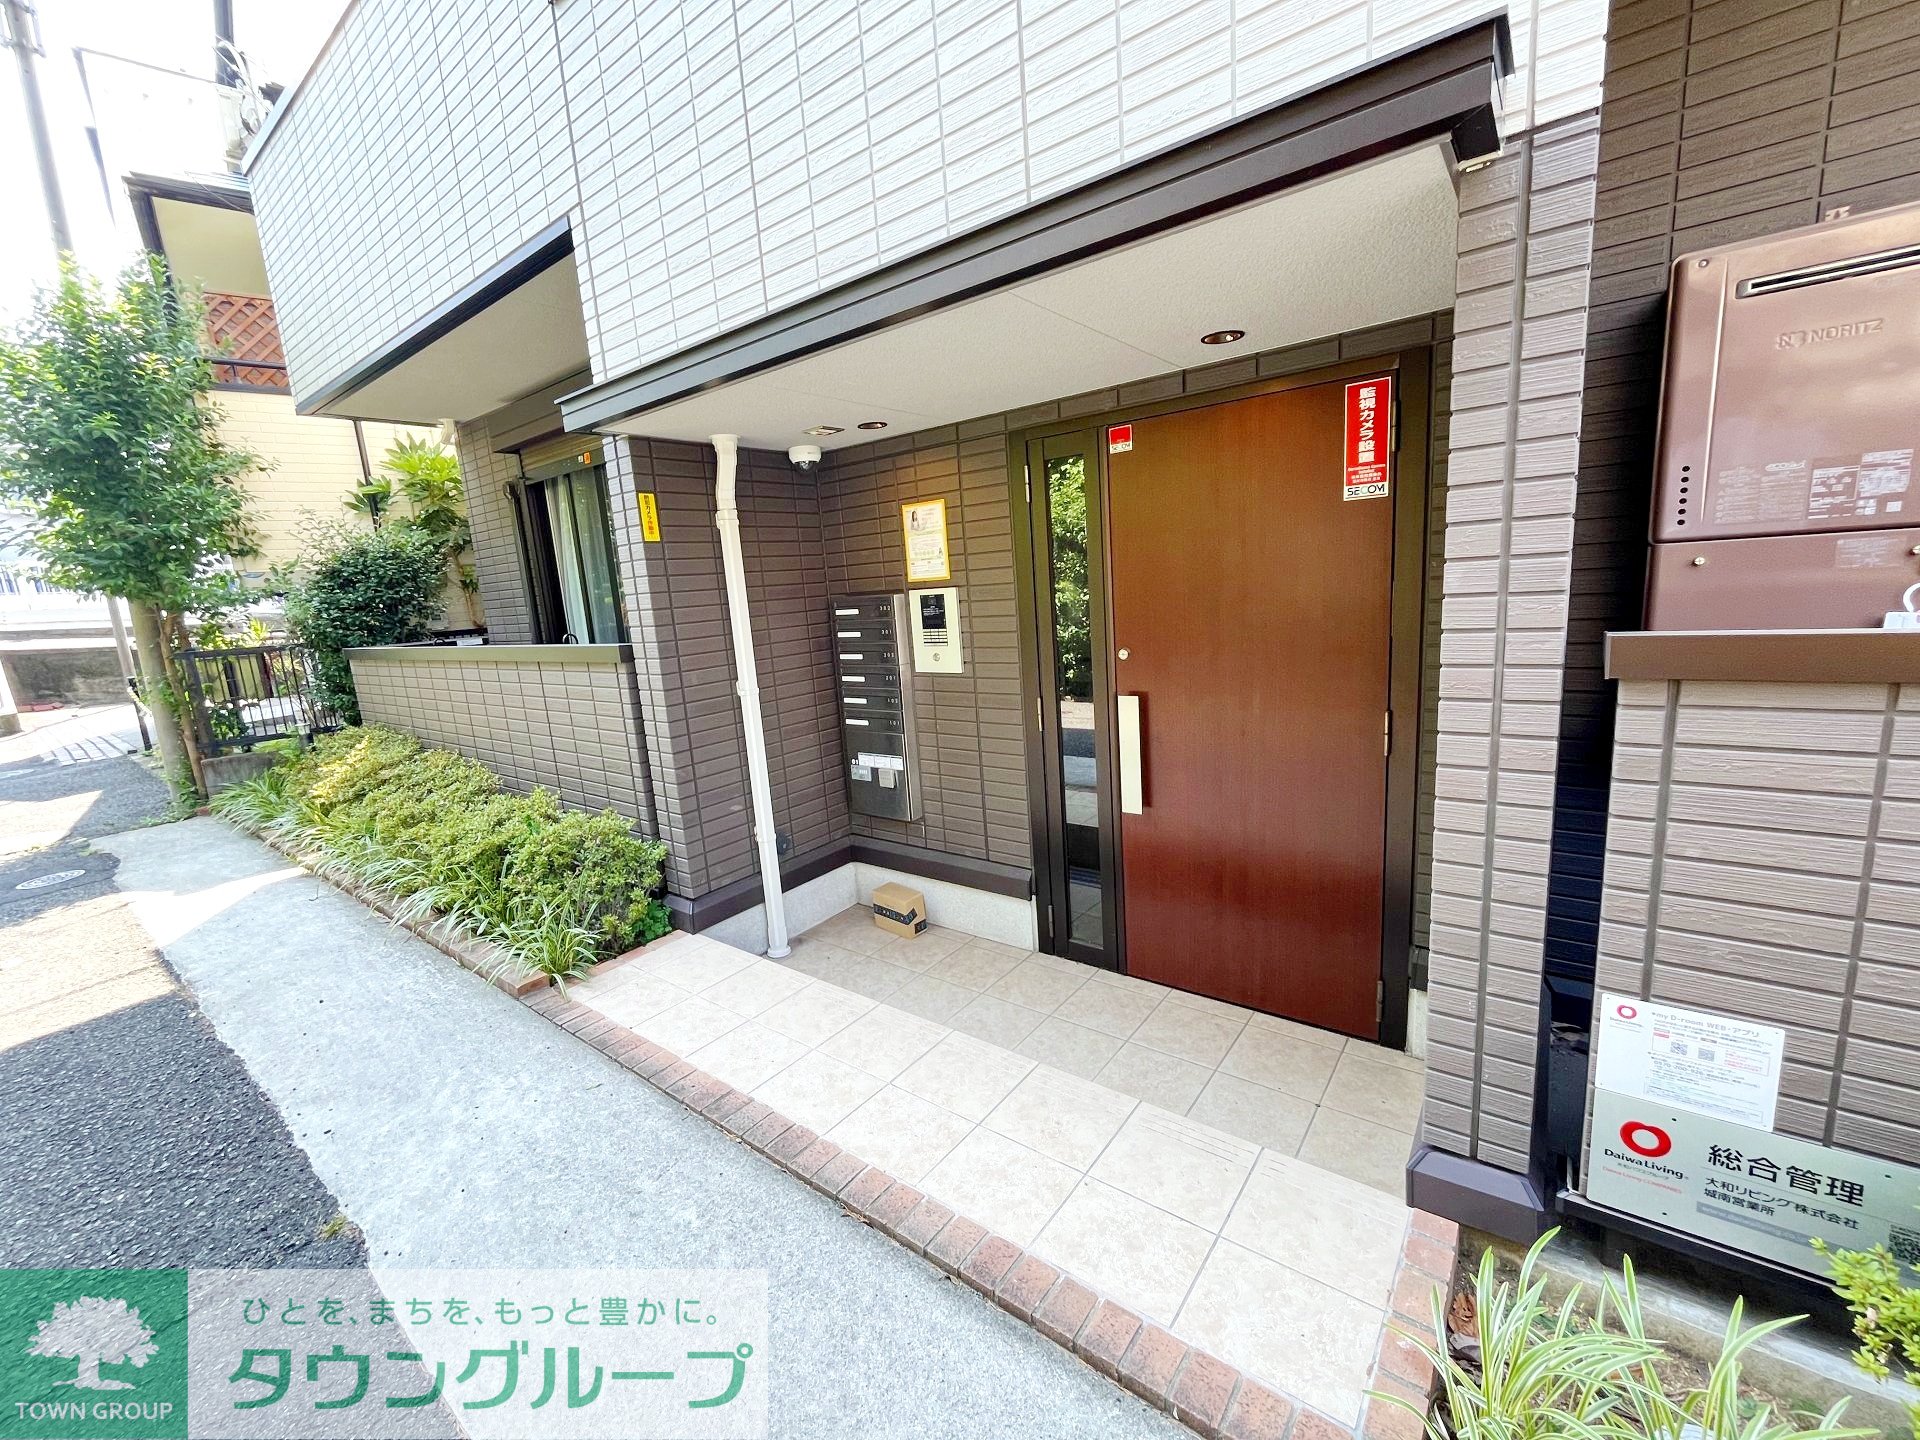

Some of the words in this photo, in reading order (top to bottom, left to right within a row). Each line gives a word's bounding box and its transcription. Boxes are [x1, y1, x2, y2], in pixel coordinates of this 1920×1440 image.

[1809, 318, 1883, 343] NORITZ
[1358, 386, 1376, 464] 監視カメラ設置
[1347, 484, 1385, 496] SECOM
[1708, 1144, 1865, 1208] 総合管理
[1703, 1187, 1775, 1218] 城南営業所
[1705, 1176, 1859, 1231] 大和リビング株式会社
